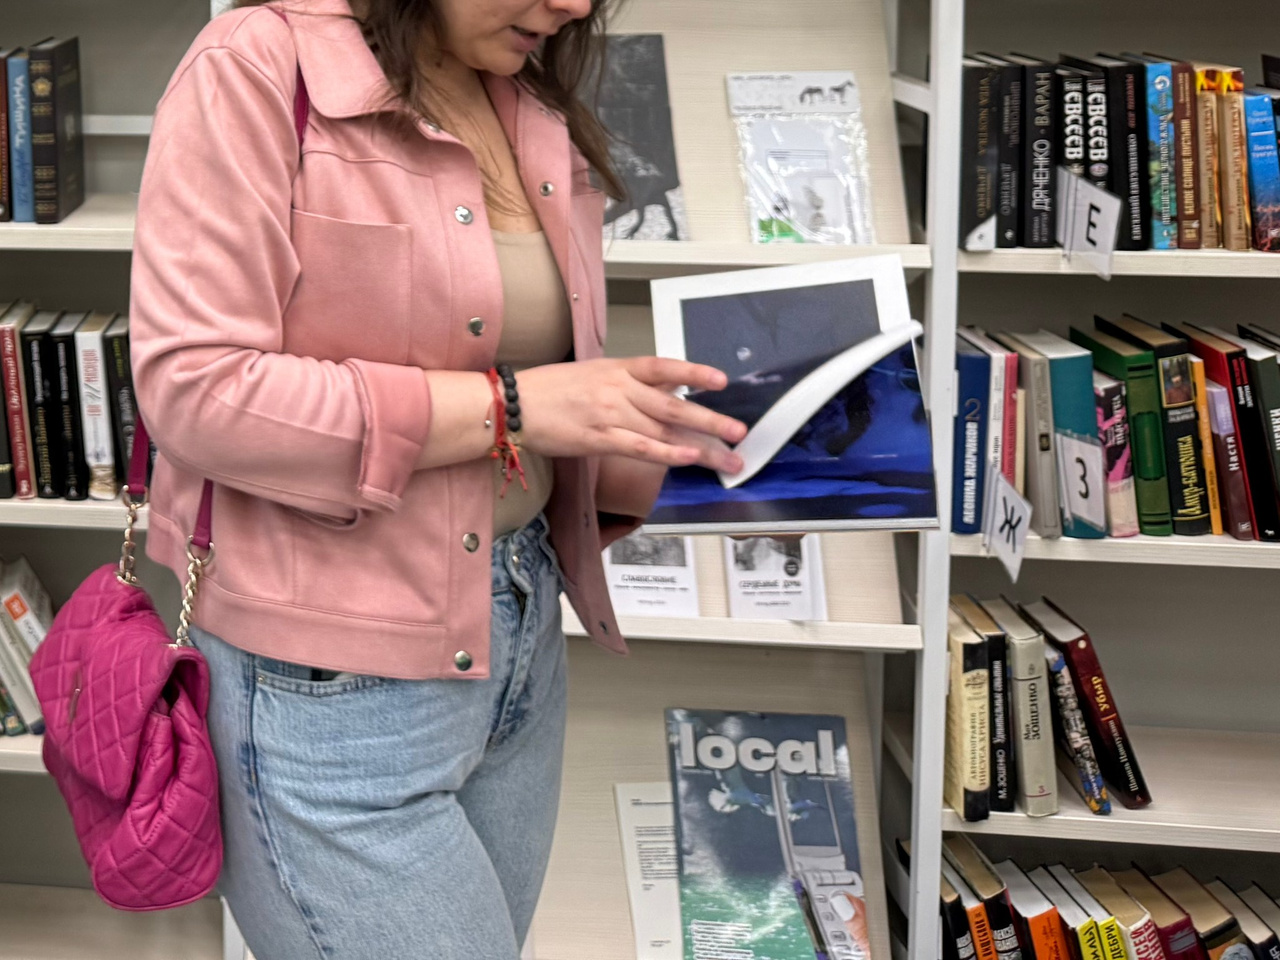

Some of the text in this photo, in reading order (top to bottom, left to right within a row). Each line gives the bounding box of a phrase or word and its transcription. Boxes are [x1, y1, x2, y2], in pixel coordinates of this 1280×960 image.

[1032, 72, 1051, 211] ДЯЧЕНКО ВАРАН
[1180, 119, 1194, 214] БЕЛОЕ СОЛНЦЕ ПУСТЫНИ
[1086, 203, 1101, 247] Е
[1075, 457, 1089, 499] З
[1177, 435, 1205, 515] Амур-батюшка
[1225, 436, 1240, 471] Настя
[997, 496, 1022, 553] Ж
[1030, 683, 1040, 740] ЗОЩЕНКО
[1091, 676, 1110, 712] Убыр
[679, 722, 837, 777] local
[970, 712, 978, 780] АВТОБИОГРАФИЯ
[978, 704, 987, 786] ИИСУСА ХРИСТА
[997, 749, 1006, 787] ЗОЩЕНКО
[998, 788, 1007, 799] М.
[1123, 762, 1139, 791] Шамиль
[1105, 924, 1124, 959] ДЕБРИ
